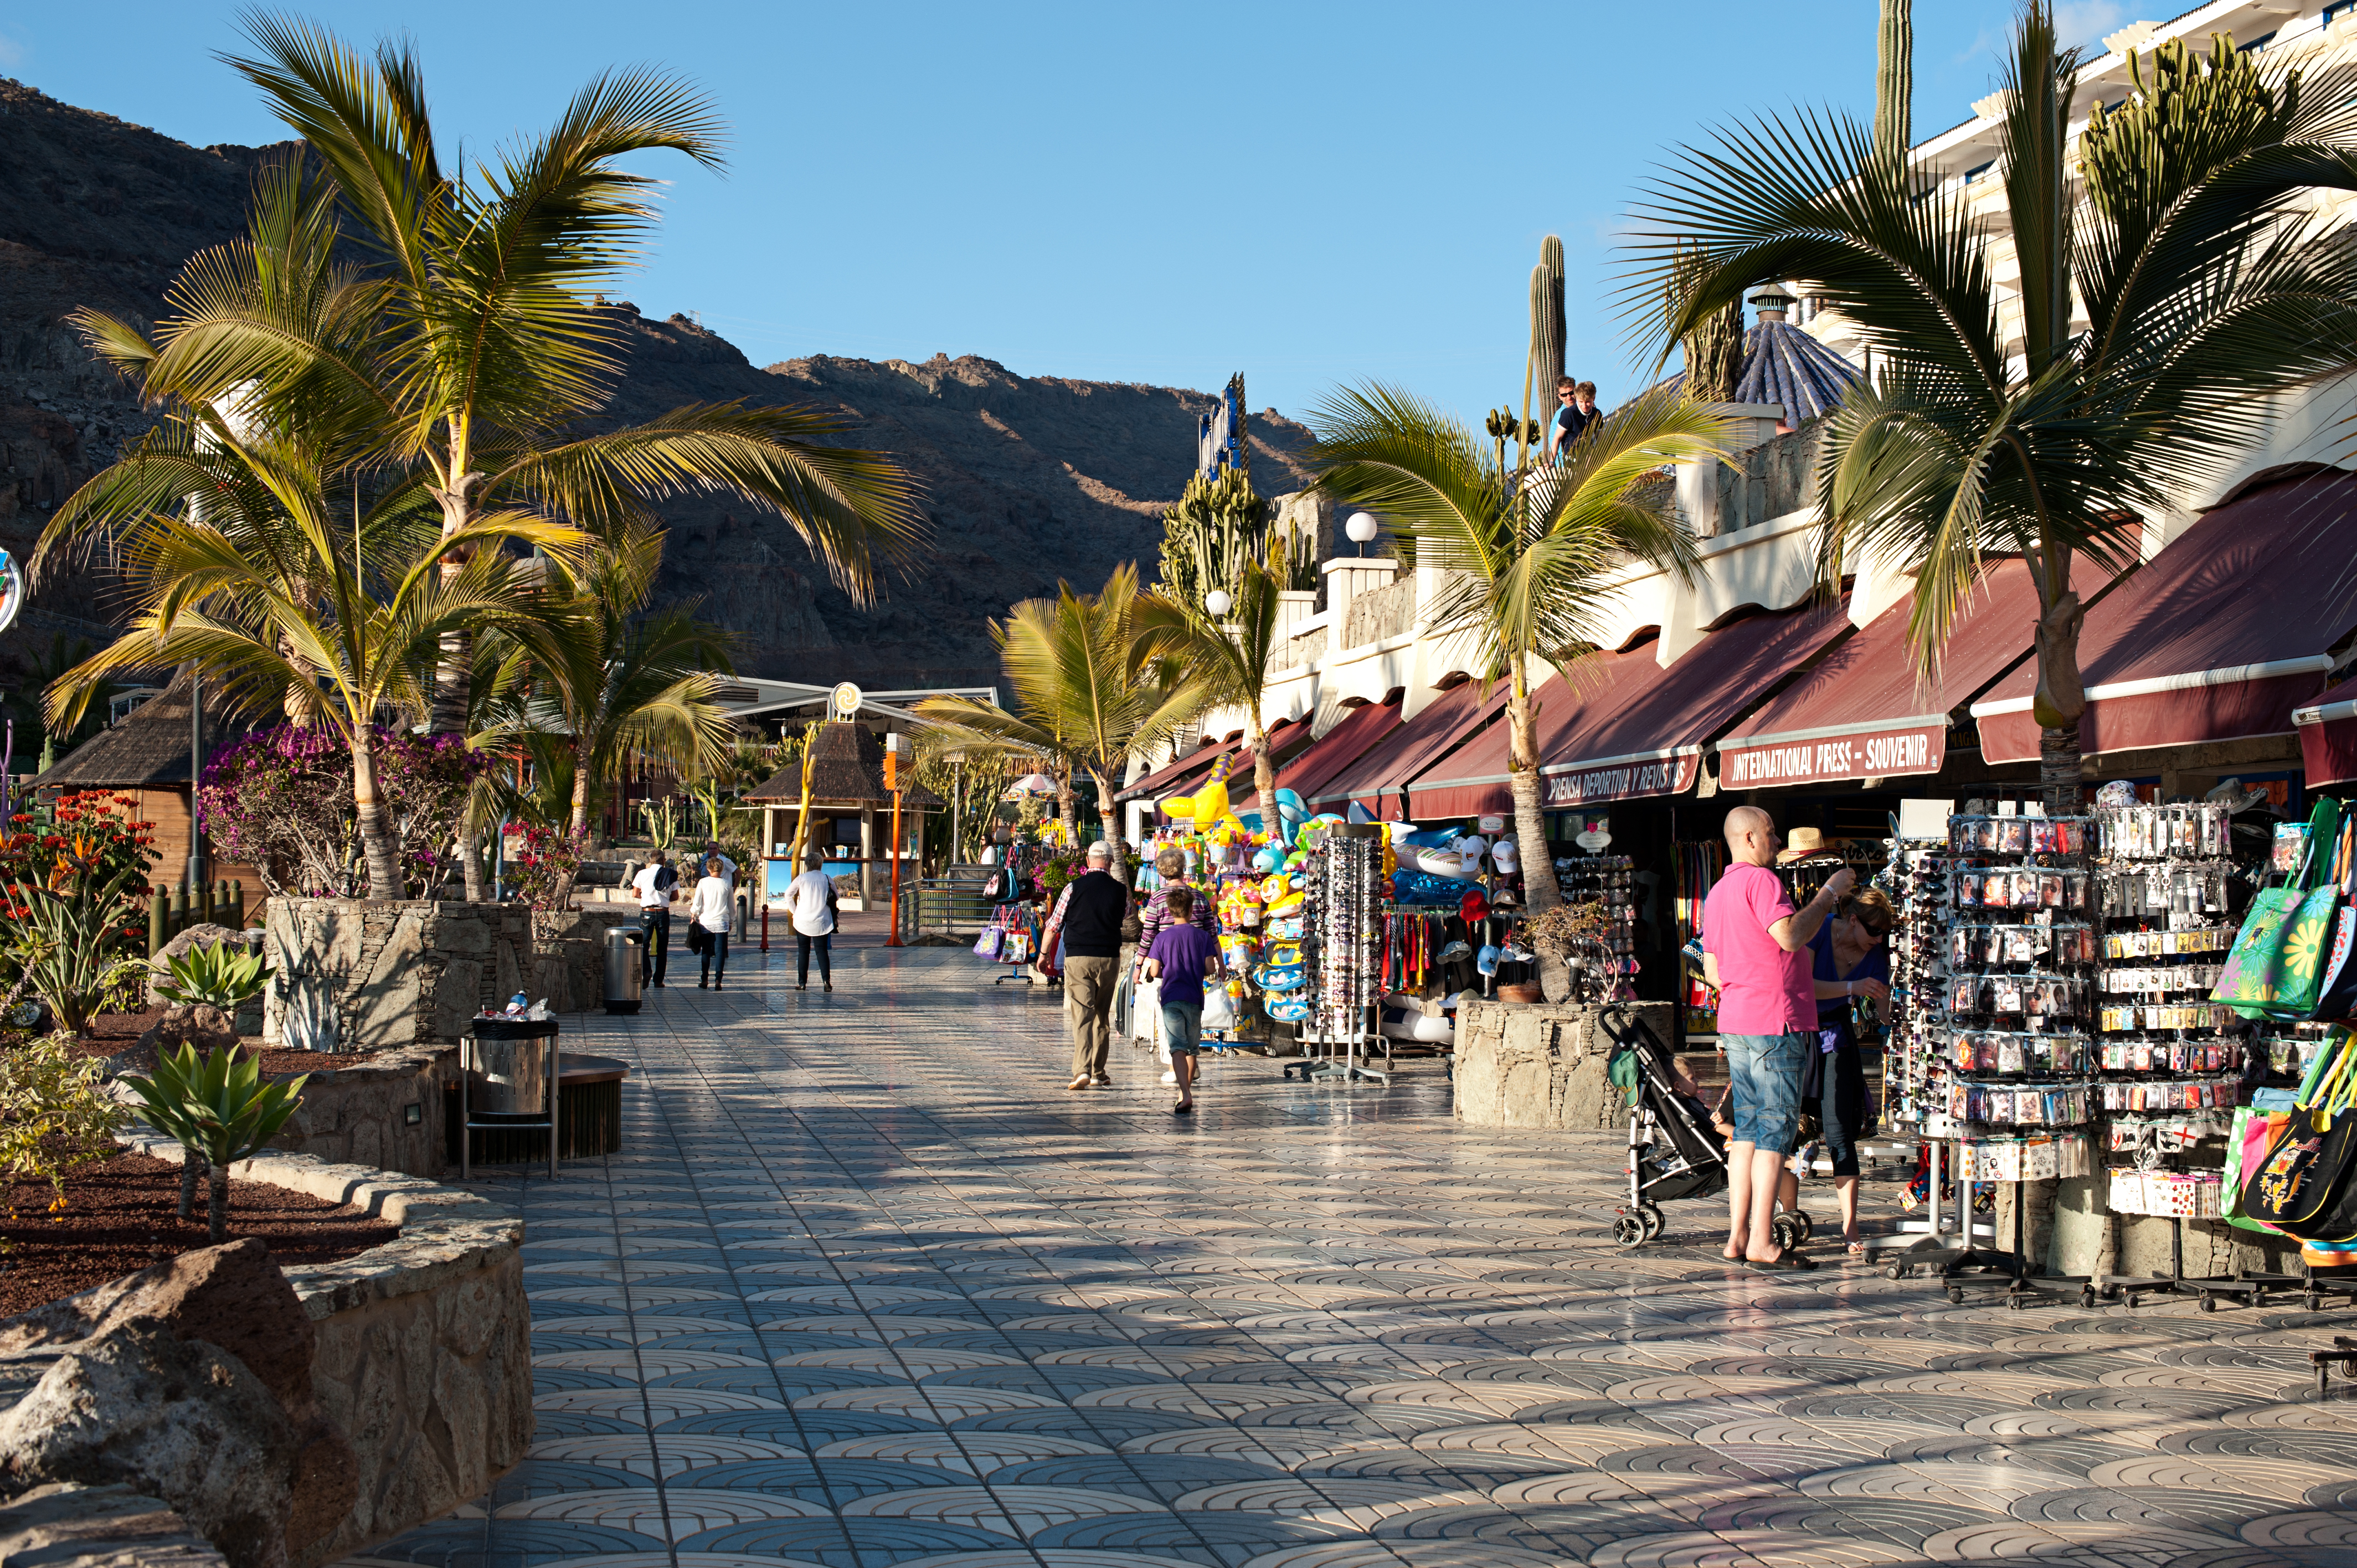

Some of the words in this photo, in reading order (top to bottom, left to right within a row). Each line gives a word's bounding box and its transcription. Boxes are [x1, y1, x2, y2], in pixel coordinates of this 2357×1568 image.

[1732, 746, 1812, 781] INTERNATIONAL
[1816, 741, 1851, 774] PRESS
[1865, 734, 1927, 770] SOUVENIR
[1548, 775, 1581, 801] PRENSA
[1582, 768, 1630, 797] DEPORTIVA
[1632, 767, 1640, 792] Y
[1638, 761, 1685, 790] REVISTAS
